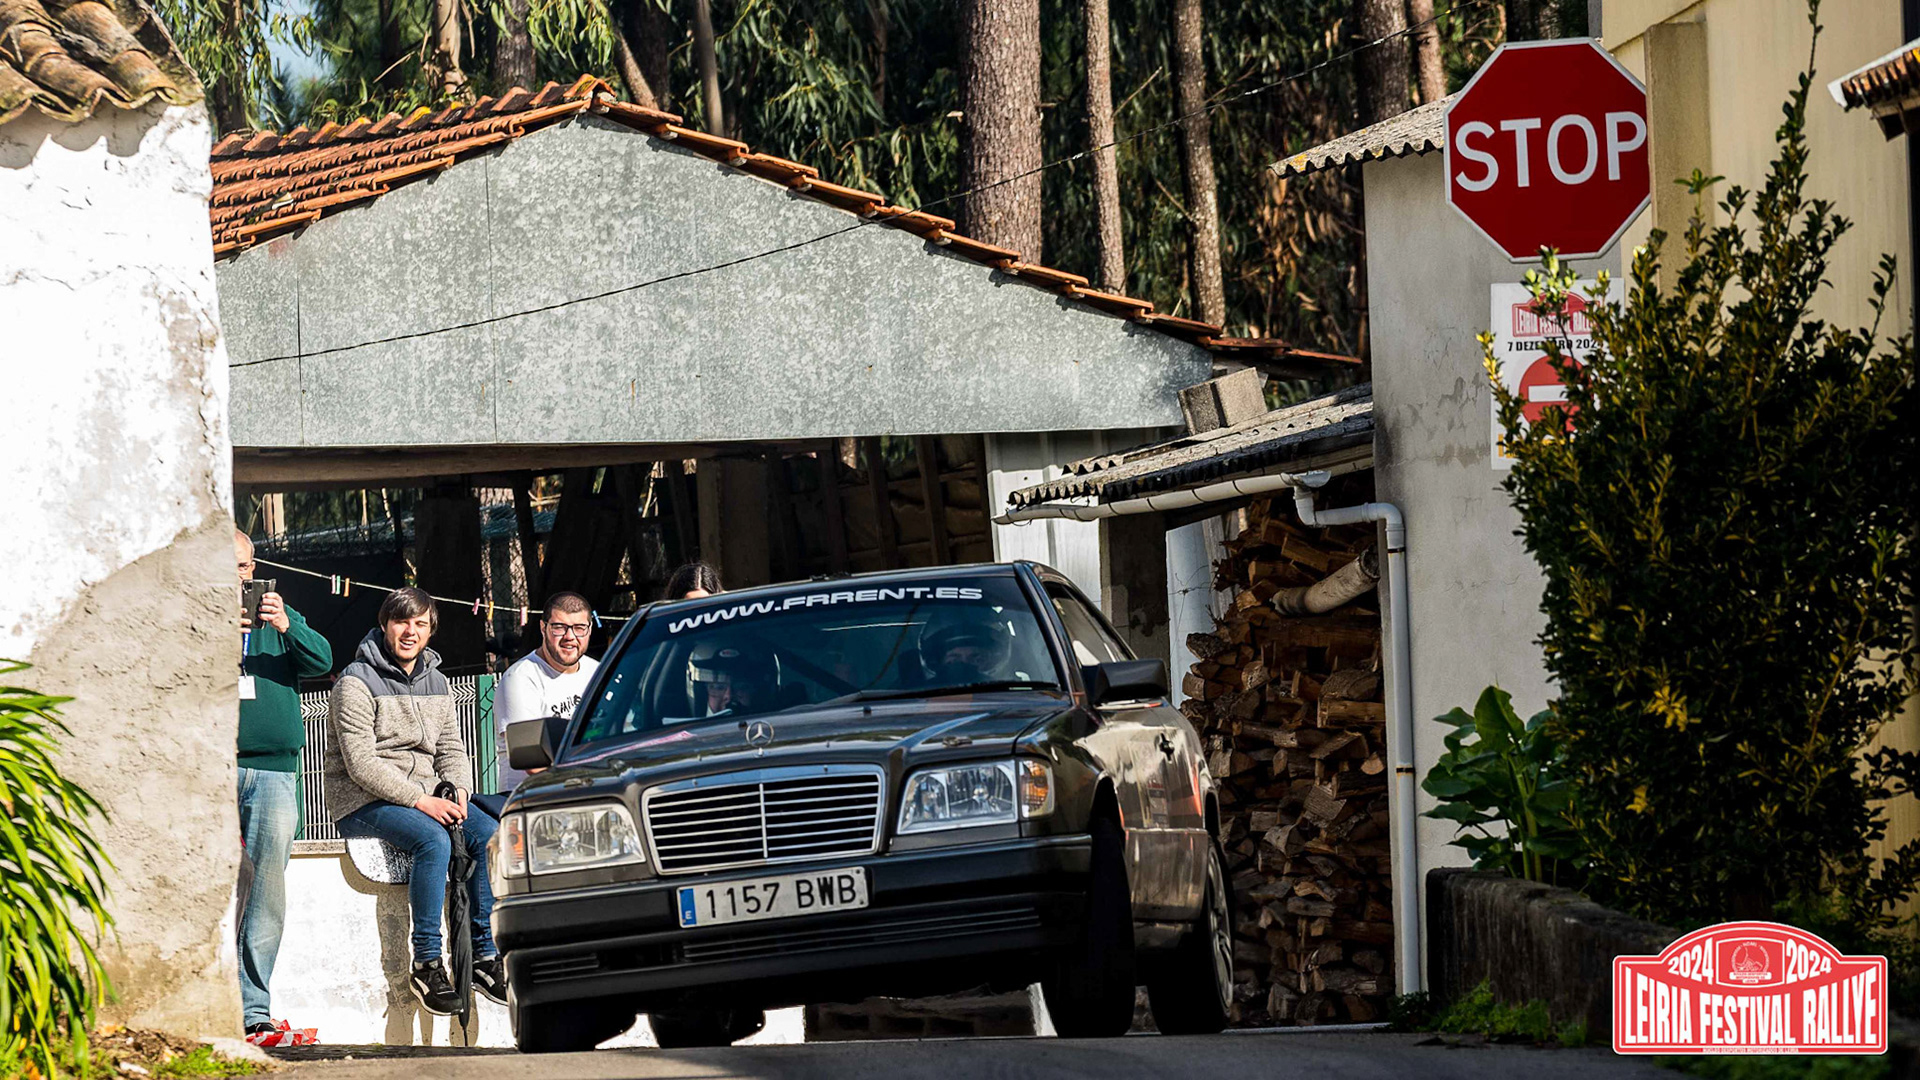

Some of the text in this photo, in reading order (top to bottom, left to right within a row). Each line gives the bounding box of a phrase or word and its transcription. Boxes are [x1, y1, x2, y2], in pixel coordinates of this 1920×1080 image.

[1455, 111, 1647, 192] STOP
[1508, 342, 1513, 352] 7
[1576, 339, 1602, 349] 202
[706, 874, 857, 918] 1157 BWB
[684, 910, 692, 920] E
